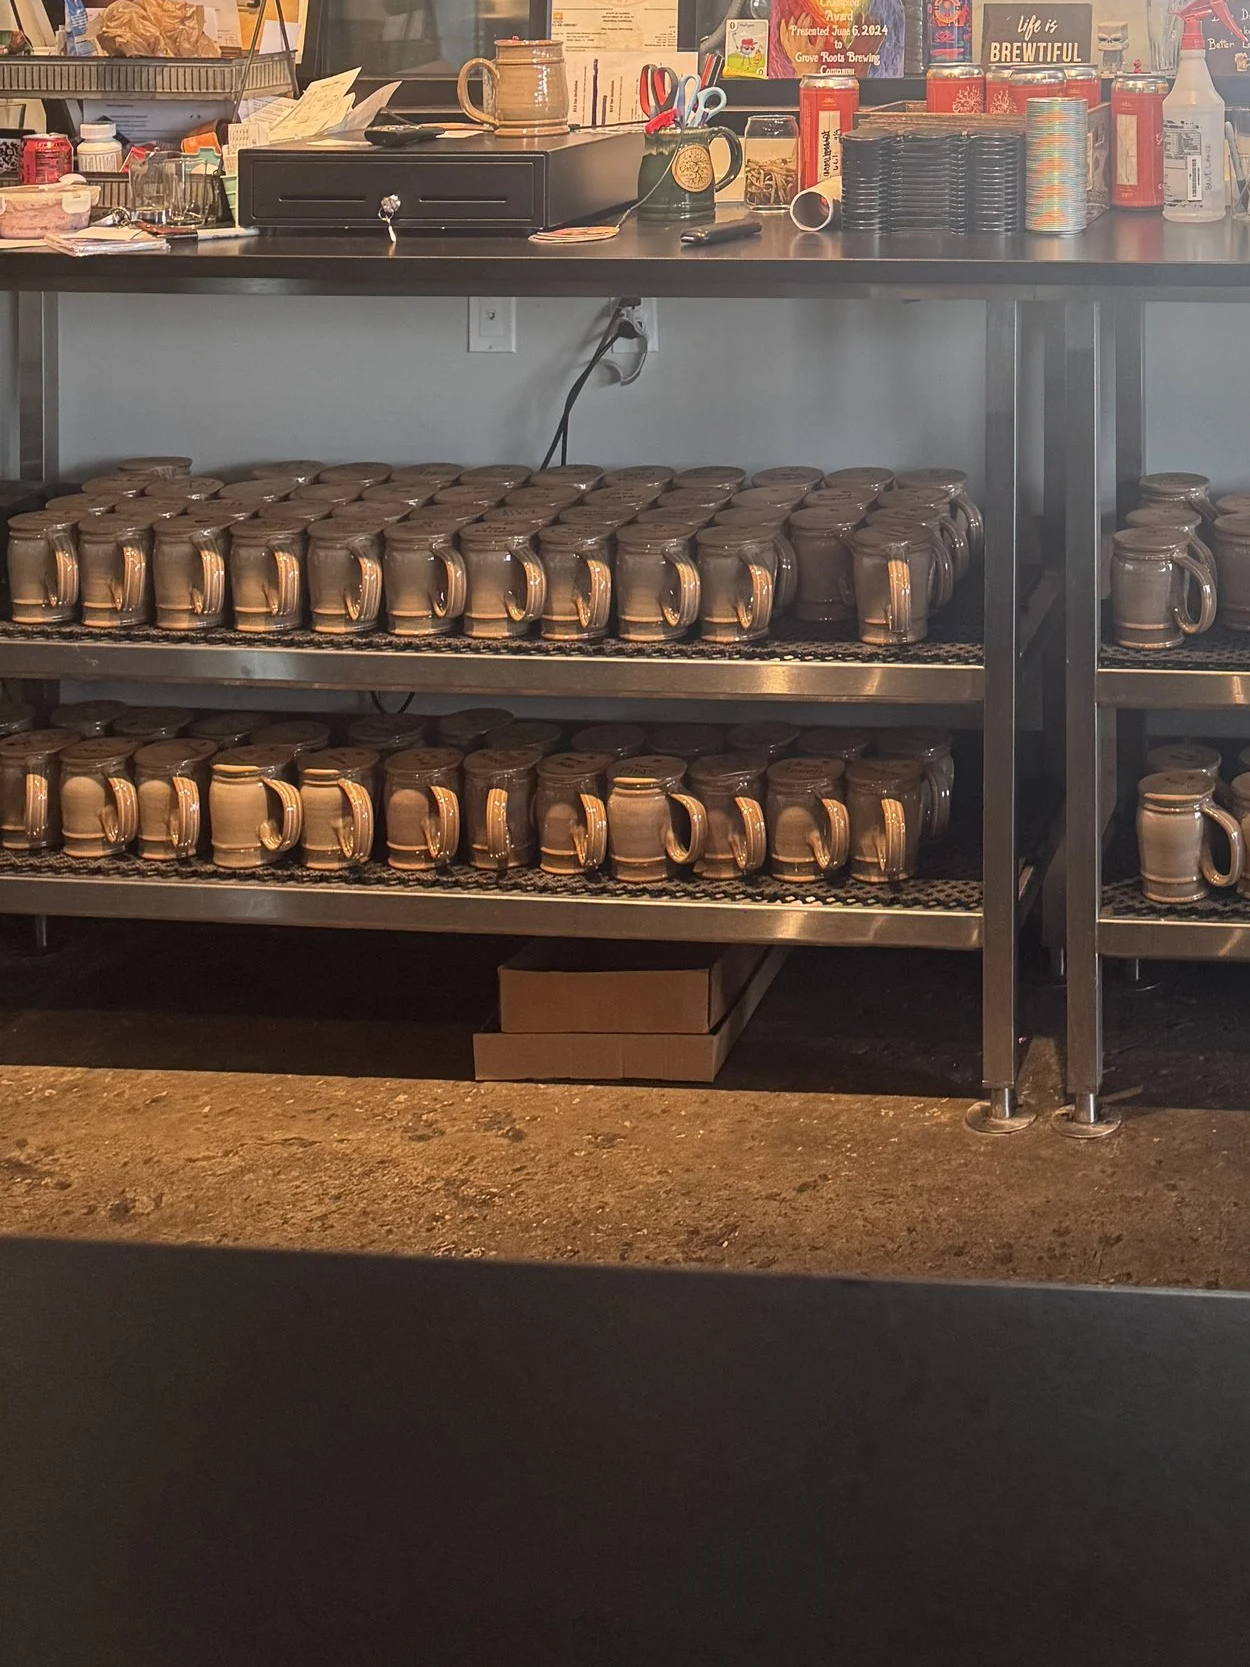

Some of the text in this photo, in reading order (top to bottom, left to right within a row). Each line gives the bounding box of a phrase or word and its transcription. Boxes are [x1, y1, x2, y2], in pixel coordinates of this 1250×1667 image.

[825, 9, 854, 21] Award
[789, 24, 830, 36] Presented
[831, 24, 851, 36] June
[861, 24, 888, 36] 2024
[1017, 14, 1058, 42] Life is
[833, 40, 843, 50] to
[1207, 37, 1235, 50] Better
[795, 51, 881, 65] Grove Roots Brewing
[989, 42, 1082, 63] BREWTIFUL
[819, 64, 855, 75] Company
